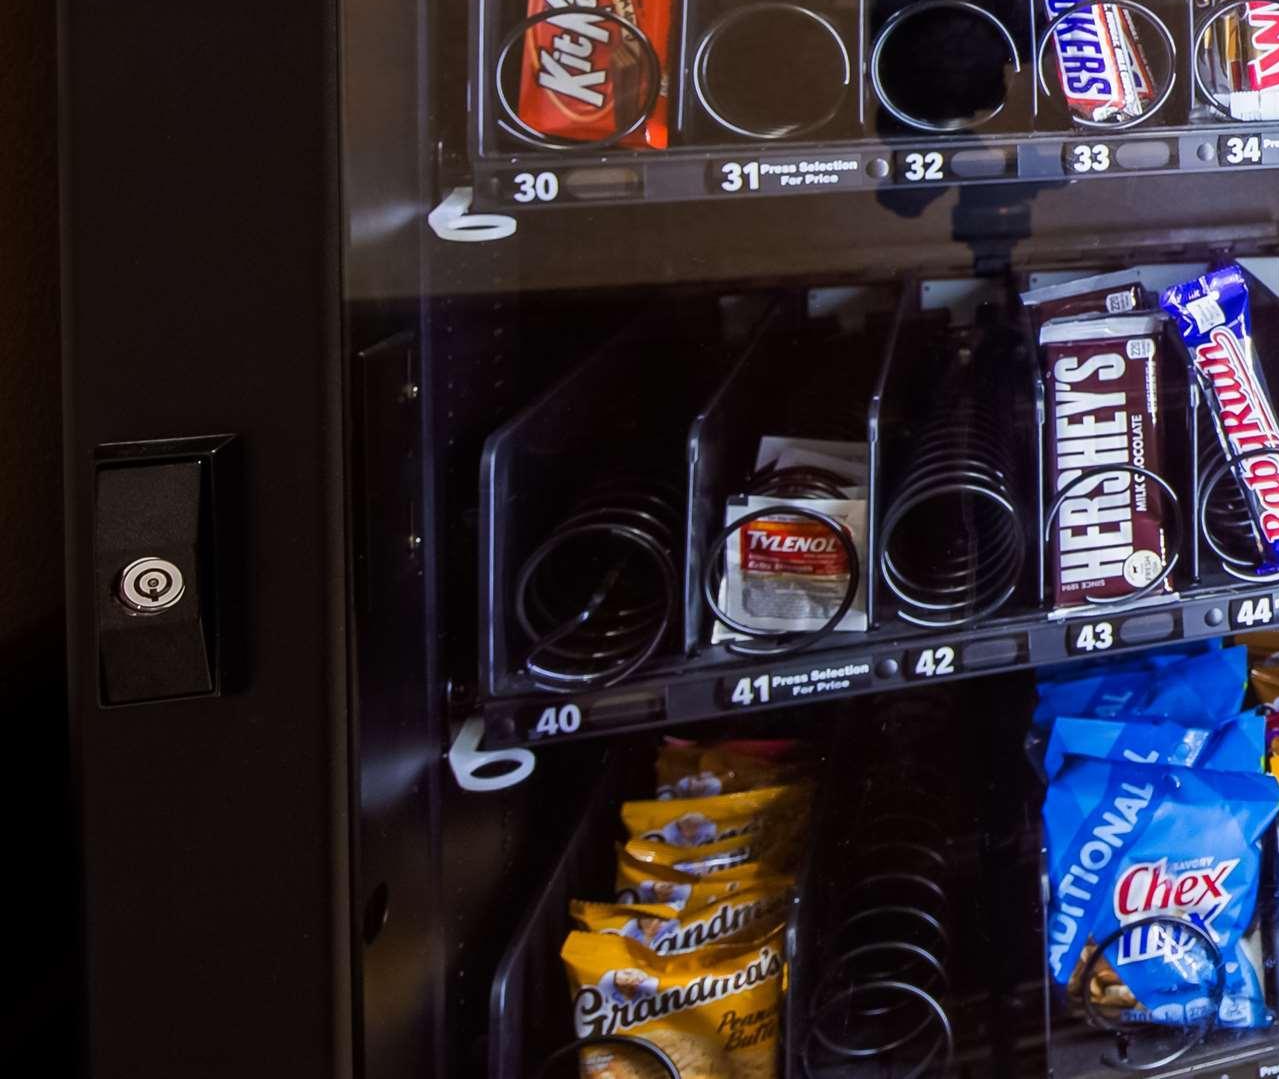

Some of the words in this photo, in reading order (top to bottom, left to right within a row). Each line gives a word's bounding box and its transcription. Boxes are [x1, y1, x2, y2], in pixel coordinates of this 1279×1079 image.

[1073, 144, 1110, 172] 33
[1226, 137, 1262, 164] 34
[721, 161, 760, 192] 31
[760, 163, 796, 176] Press
[798, 159, 858, 173] Selection
[780, 174, 803, 187] For
[804, 172, 839, 186] Price
[904, 152, 944, 181] 32
[513, 172, 558, 202] 30
[1131, 414, 1146, 483] COCOLATE
[1053, 352, 1135, 585] HERSHEY'S
[1135, 485, 1148, 512] MILK
[747, 530, 838, 553] TYLENOL
[1236, 597, 1273, 626] 44
[1076, 622, 1114, 651] 43
[914, 645, 956, 676] 42
[731, 673, 771, 706] 41
[772, 670, 808, 689] Press
[809, 662, 870, 684] Selection
[792, 683, 815, 696] For
[816, 678, 850, 692] Price
[536, 703, 582, 735] 40
[1118, 864, 1231, 916] Chex
[575, 948, 782, 1038] Grandma's
